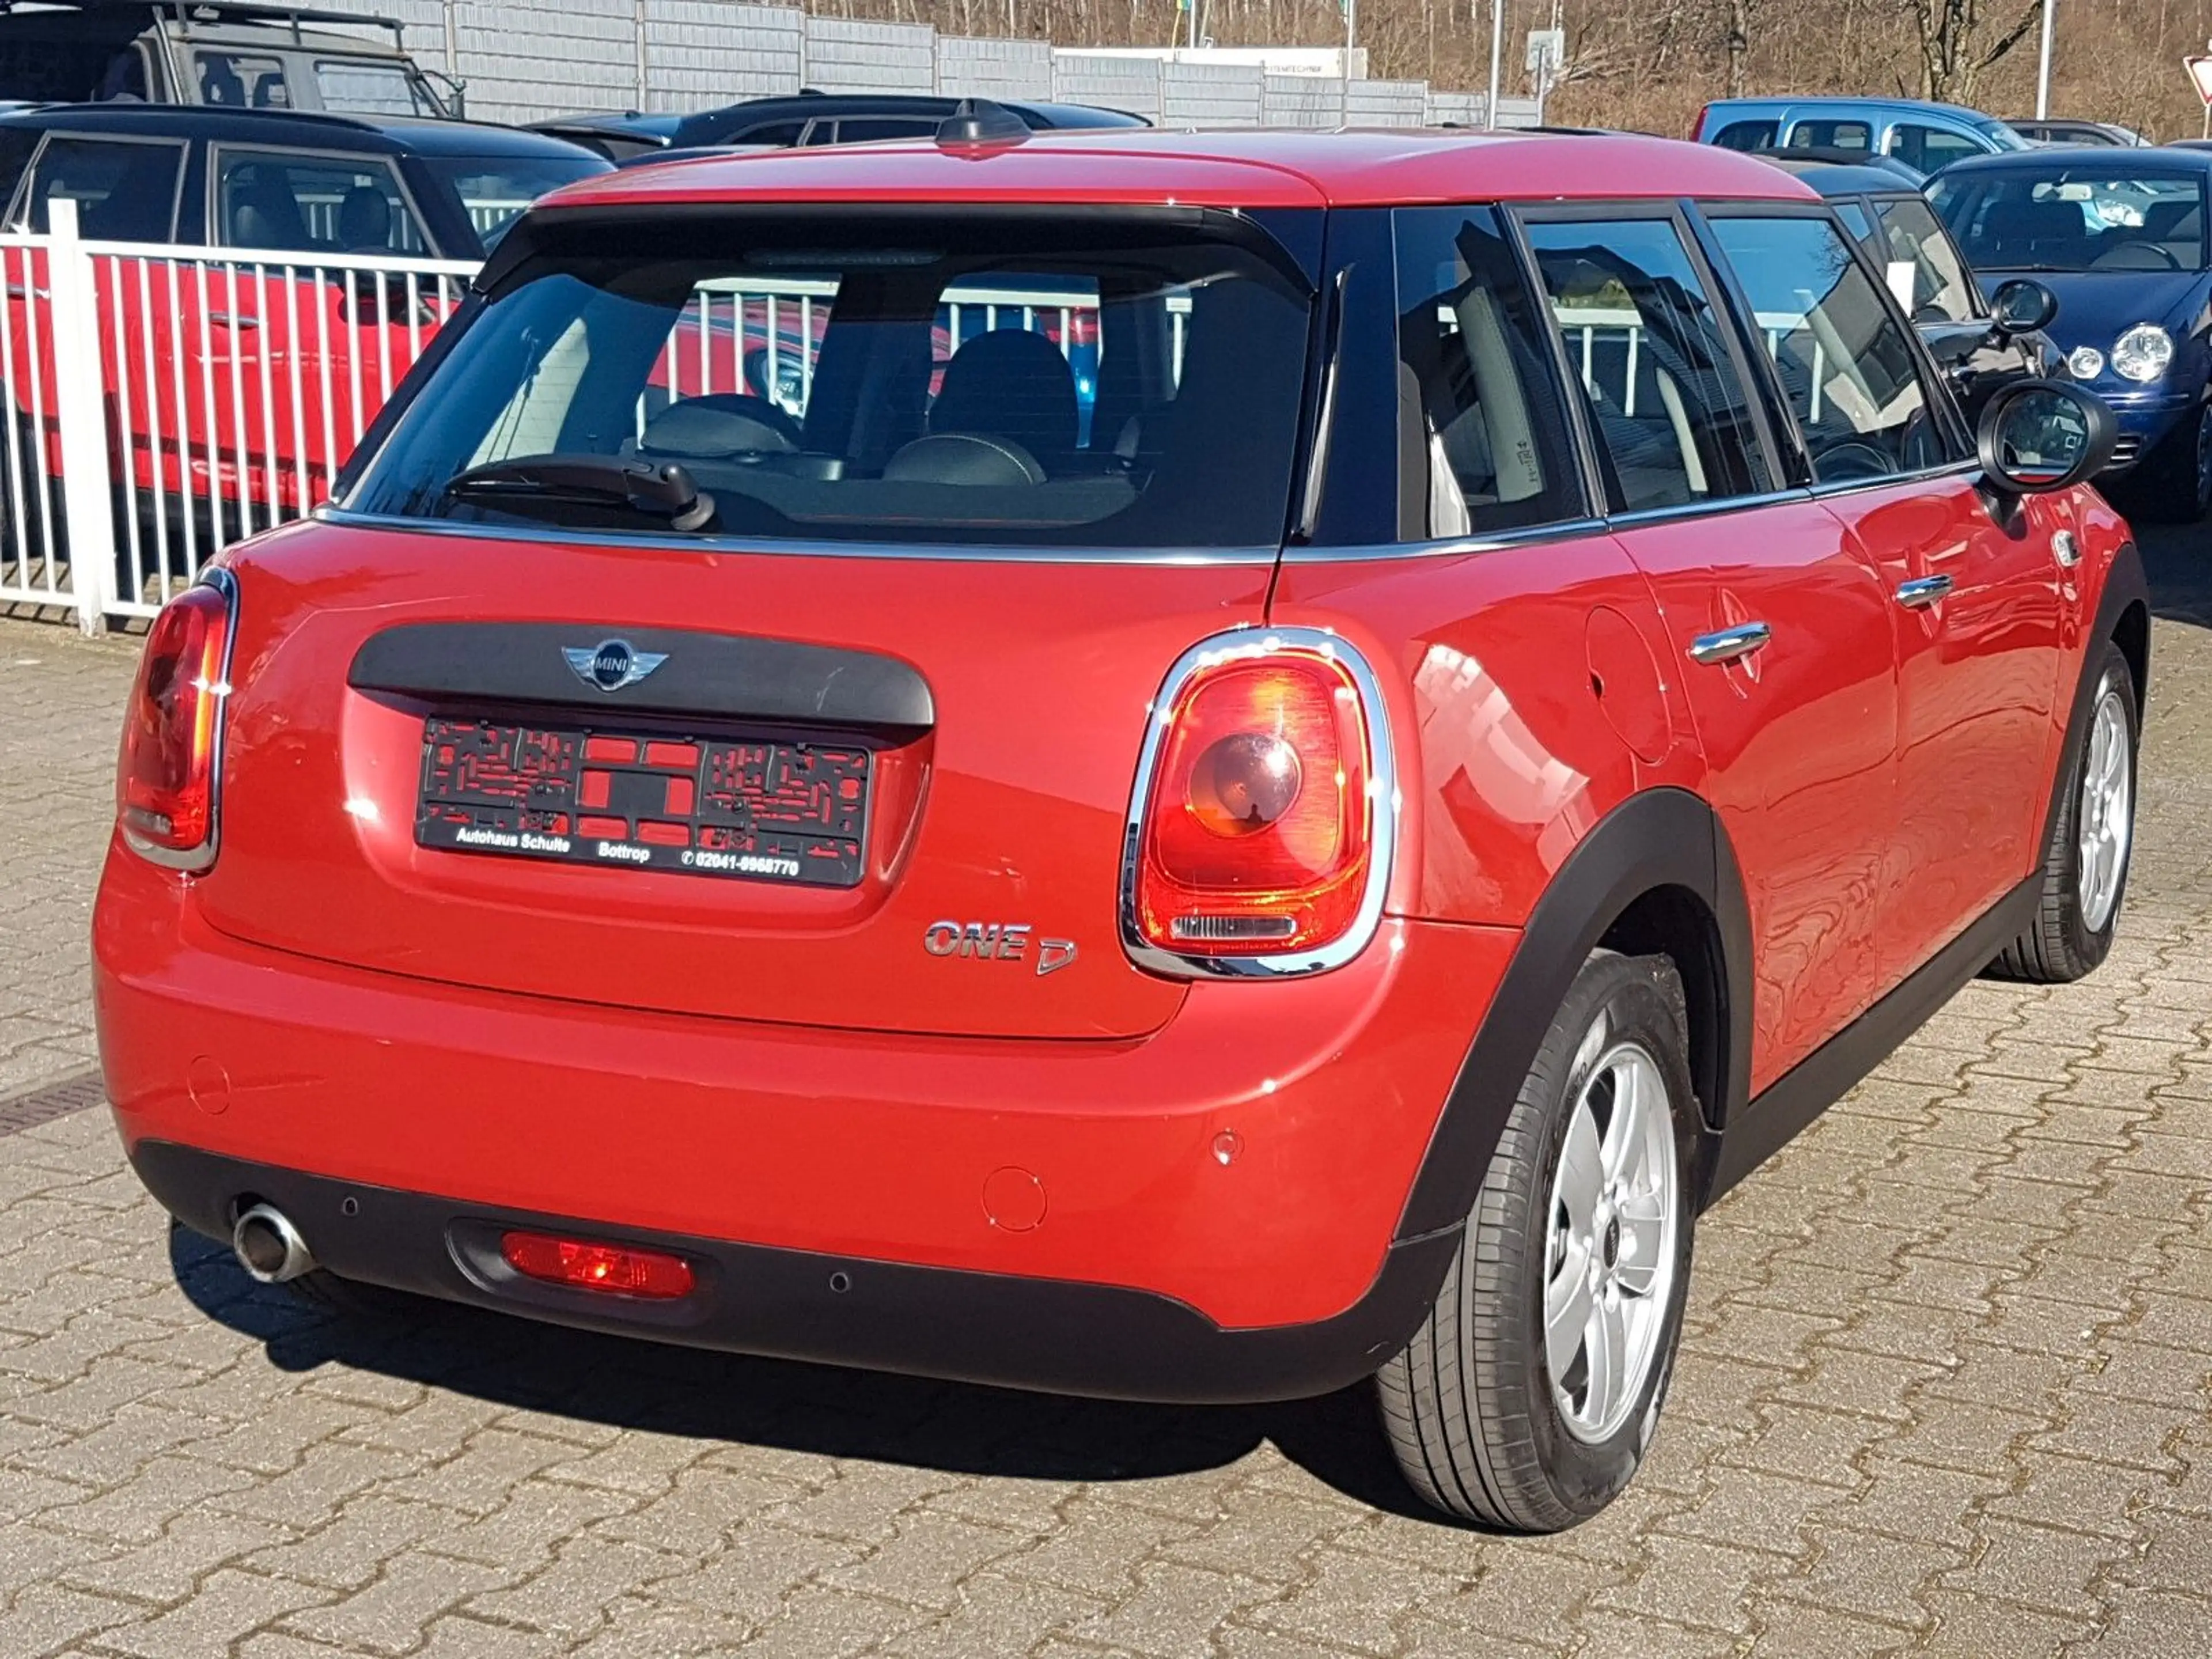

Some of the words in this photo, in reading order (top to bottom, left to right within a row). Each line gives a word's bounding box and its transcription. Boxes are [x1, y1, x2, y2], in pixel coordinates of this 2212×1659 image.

[596, 657, 627, 672] MINI
[456, 827, 518, 847] Autohaus
[521, 834, 571, 853] Schulte
[599, 842, 650, 863] Bottrop
[925, 919, 1031, 960] ONE
[1036, 938, 1077, 976] D
